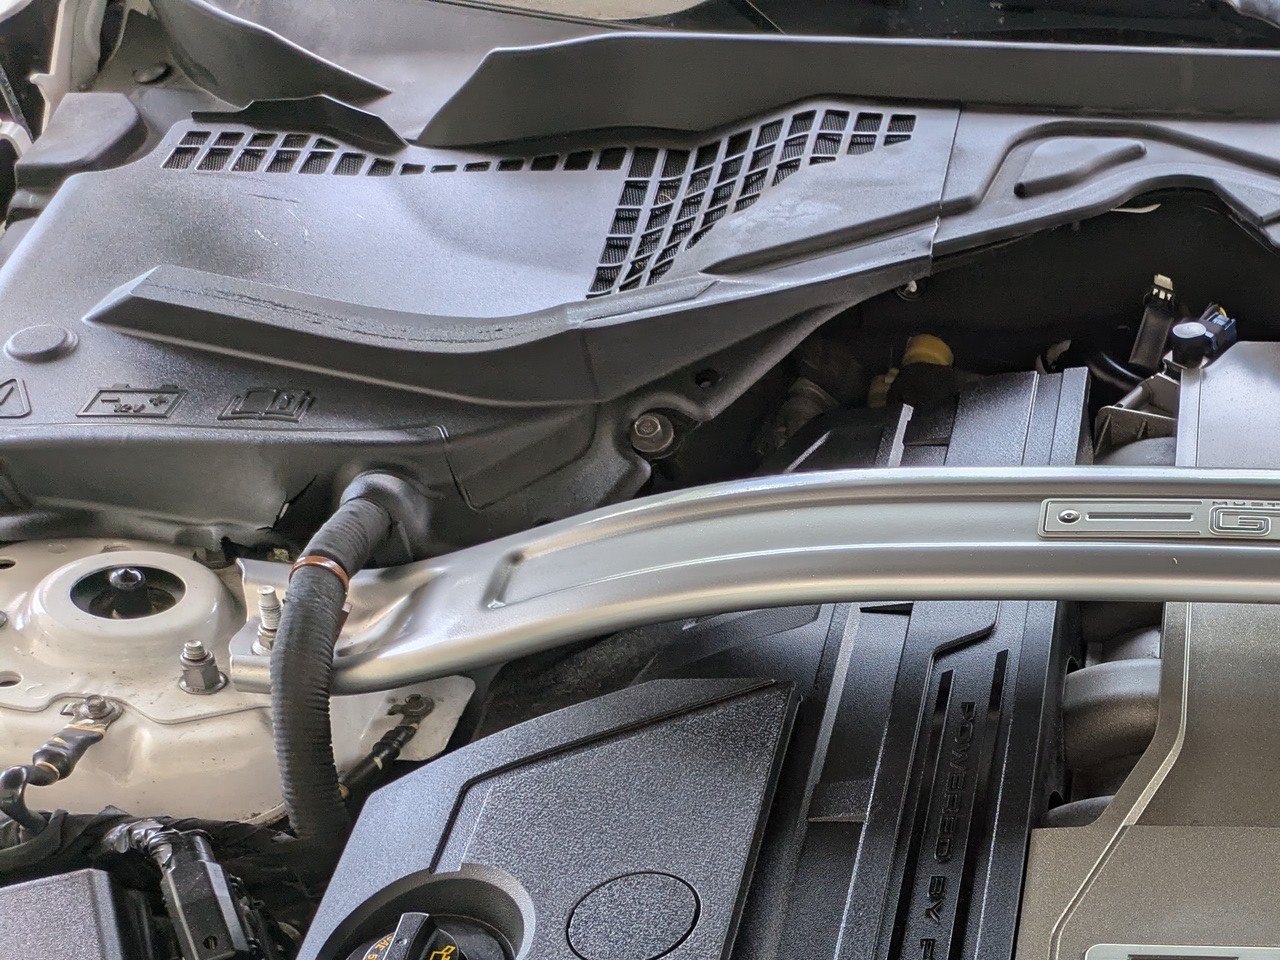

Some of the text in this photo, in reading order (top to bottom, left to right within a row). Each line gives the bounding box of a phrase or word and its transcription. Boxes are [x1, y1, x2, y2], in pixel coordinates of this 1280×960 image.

[933, 701, 977, 862] POWERED
[923, 874, 946, 923] BY
[375, 935, 393, 951] SAE
